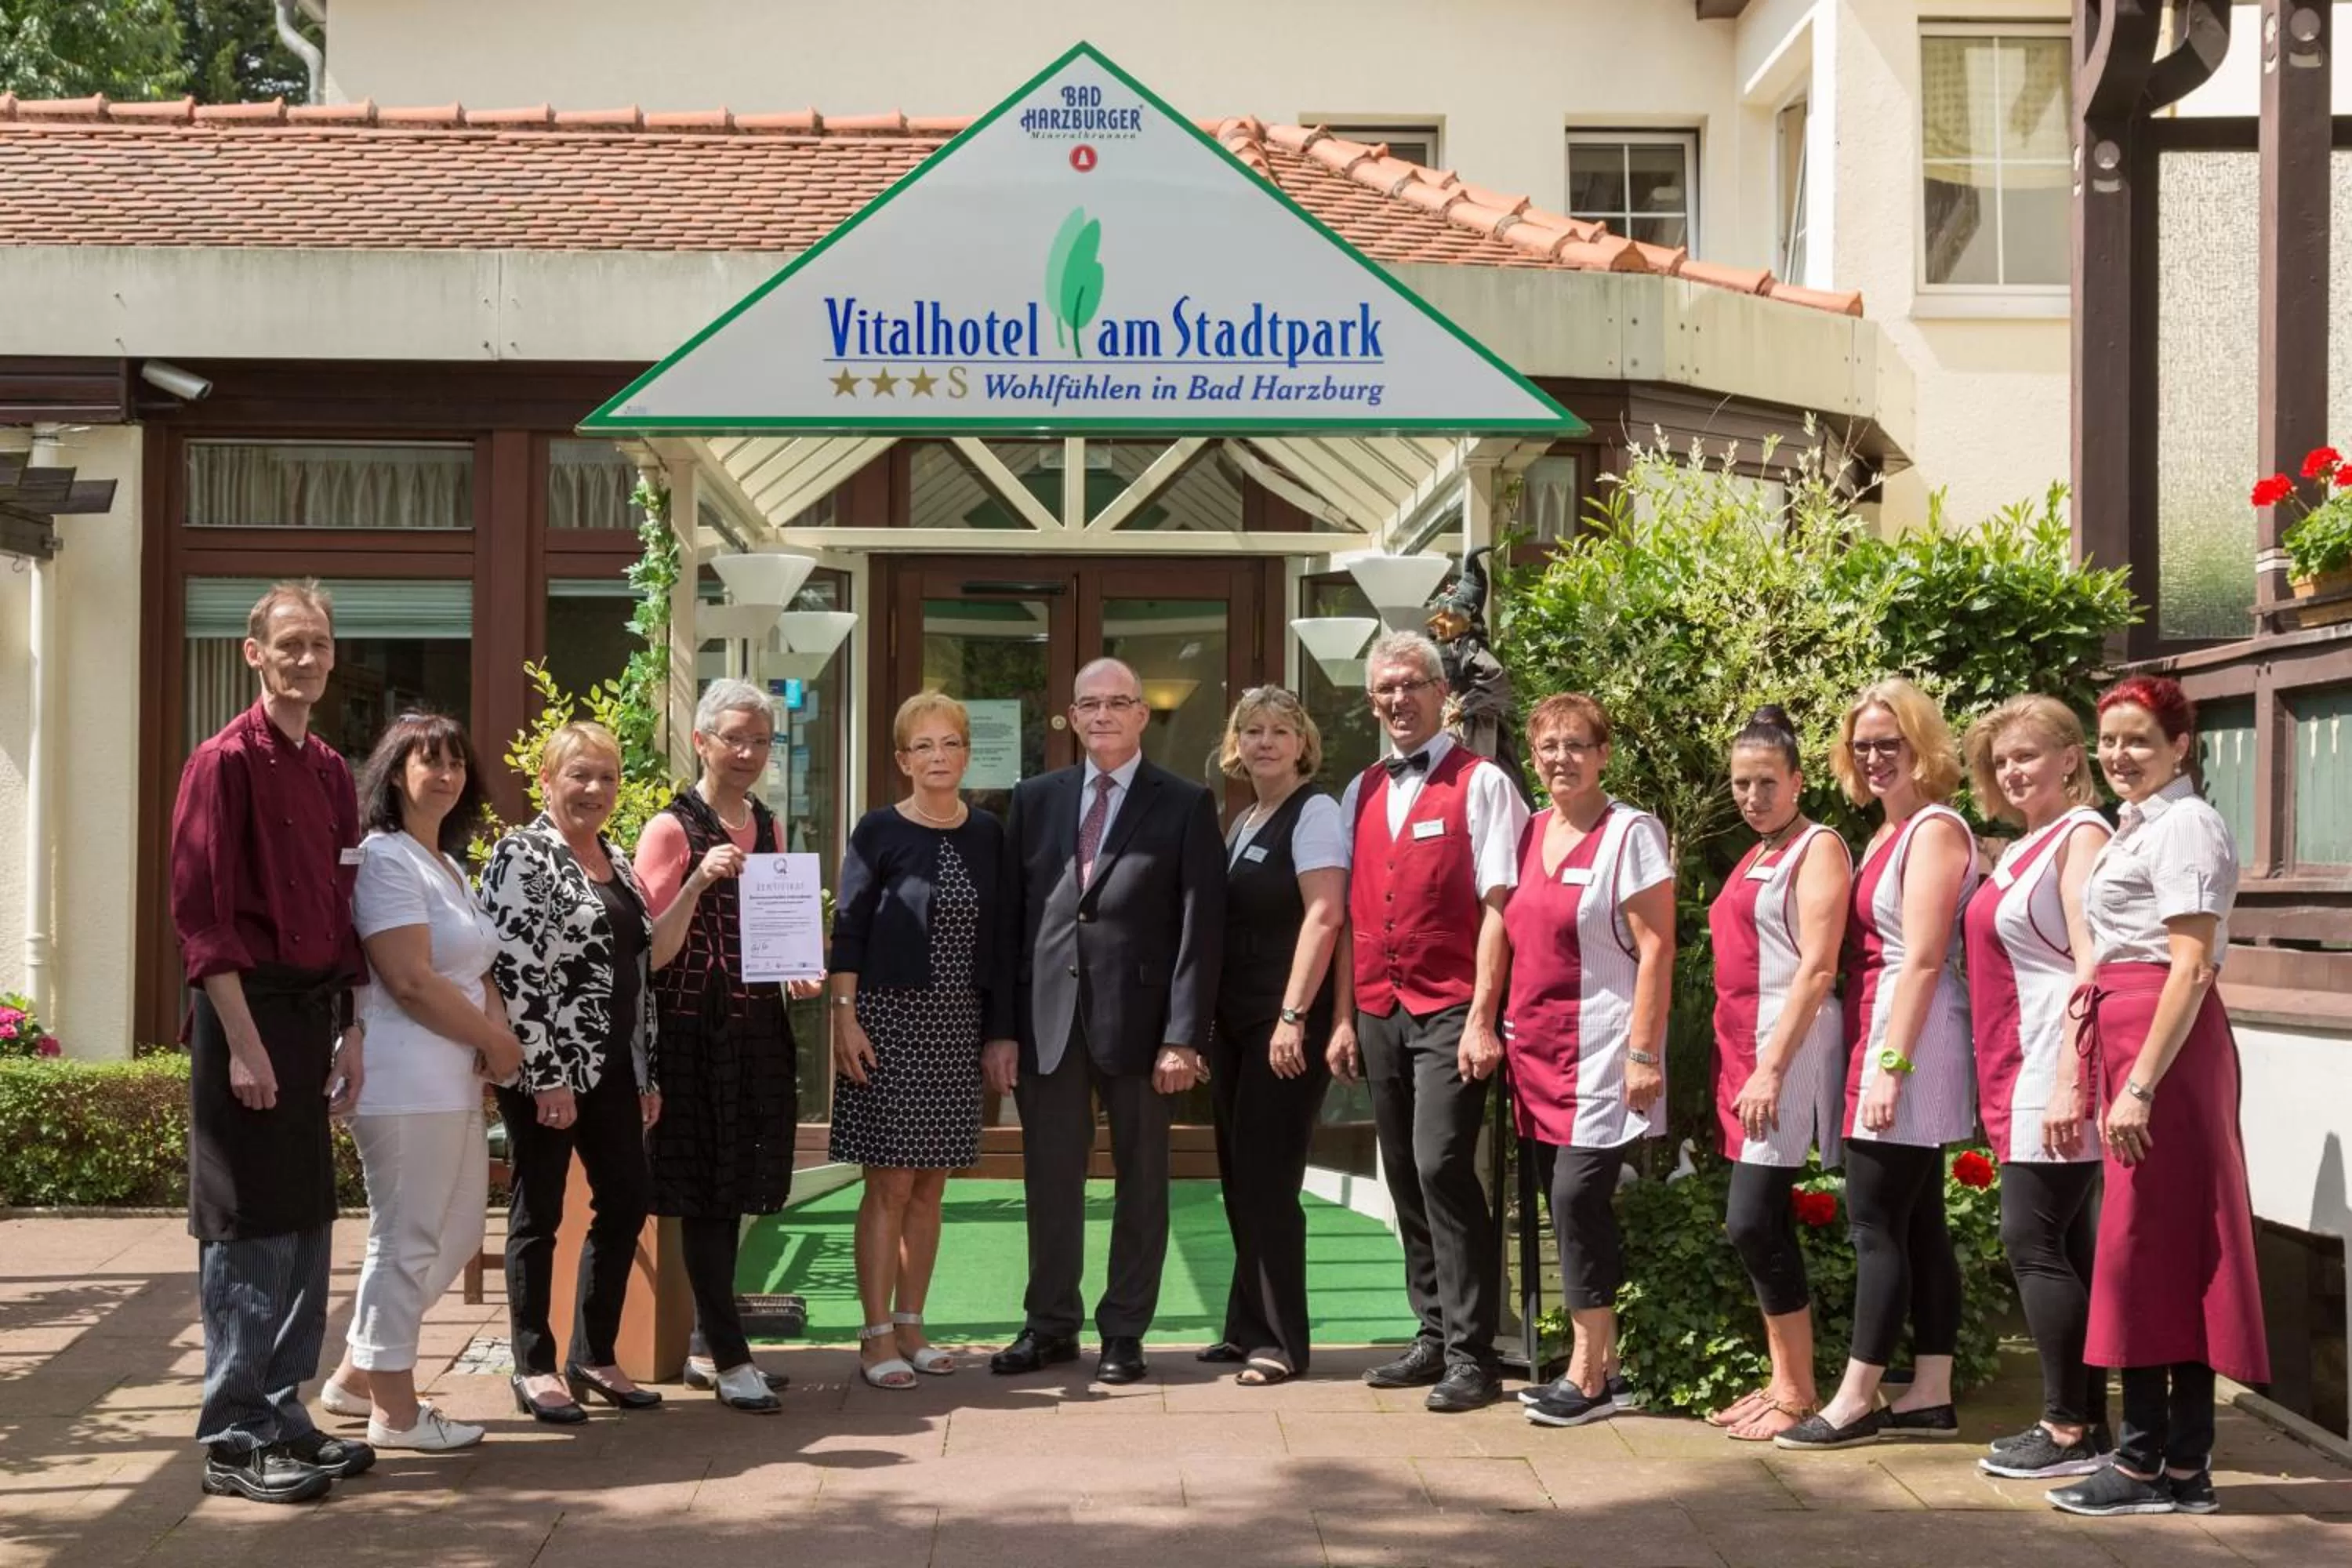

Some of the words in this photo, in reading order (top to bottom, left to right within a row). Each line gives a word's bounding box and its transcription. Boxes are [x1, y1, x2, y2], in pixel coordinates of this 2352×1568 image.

[1061, 85, 1102, 107] BAD
[1020, 108, 1142, 132] HARZBURGER
[1029, 131, 1137, 140] Mineralbrunnen
[823, 297, 1039, 357] Vitalhotel
[1098, 319, 1162, 357] am
[1172, 296, 1384, 368] Stadtpark
[947, 366, 969, 399] S
[985, 372, 1142, 407] Wohlfühlen
[1151, 376, 1177, 401] in
[1186, 375, 1245, 401] Bad
[1250, 375, 1385, 406] Harzburg
